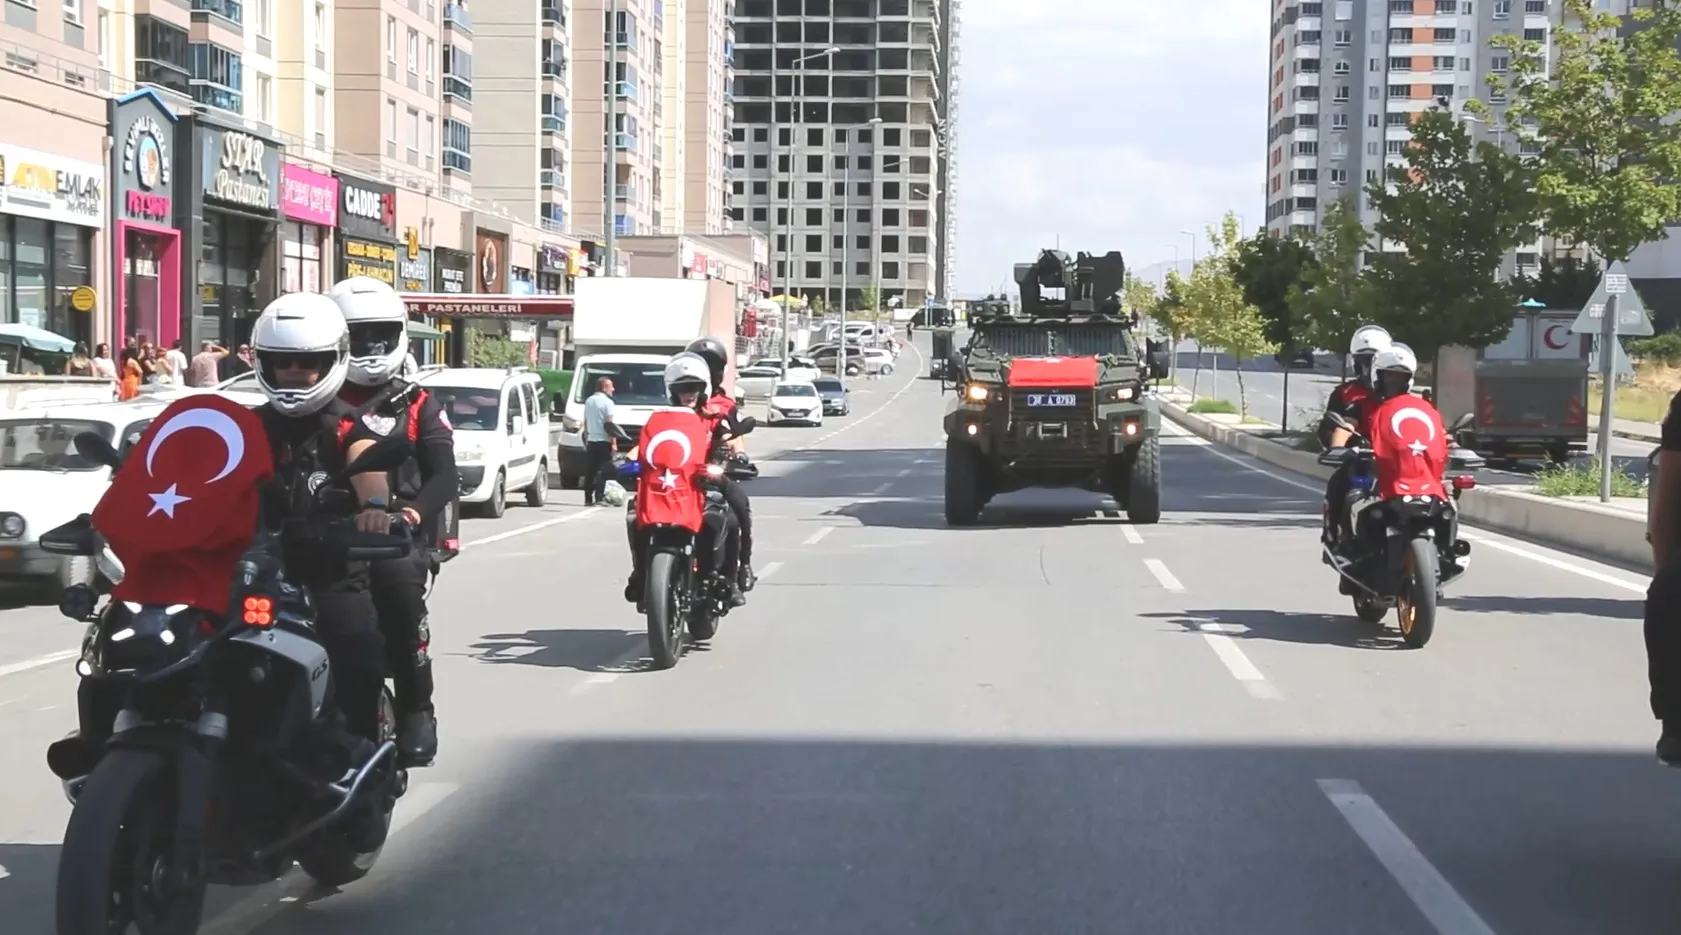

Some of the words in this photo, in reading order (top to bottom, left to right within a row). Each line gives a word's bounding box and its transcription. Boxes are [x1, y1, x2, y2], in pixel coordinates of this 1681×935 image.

[222, 131, 266, 181] STAR
[56, 169, 101, 201] EMLAK
[217, 169, 270, 209] Pastanesi
[345, 185, 380, 220] CADDE
[427, 303, 521, 313] PASTANELERİ
[312, 658, 328, 682] GS
